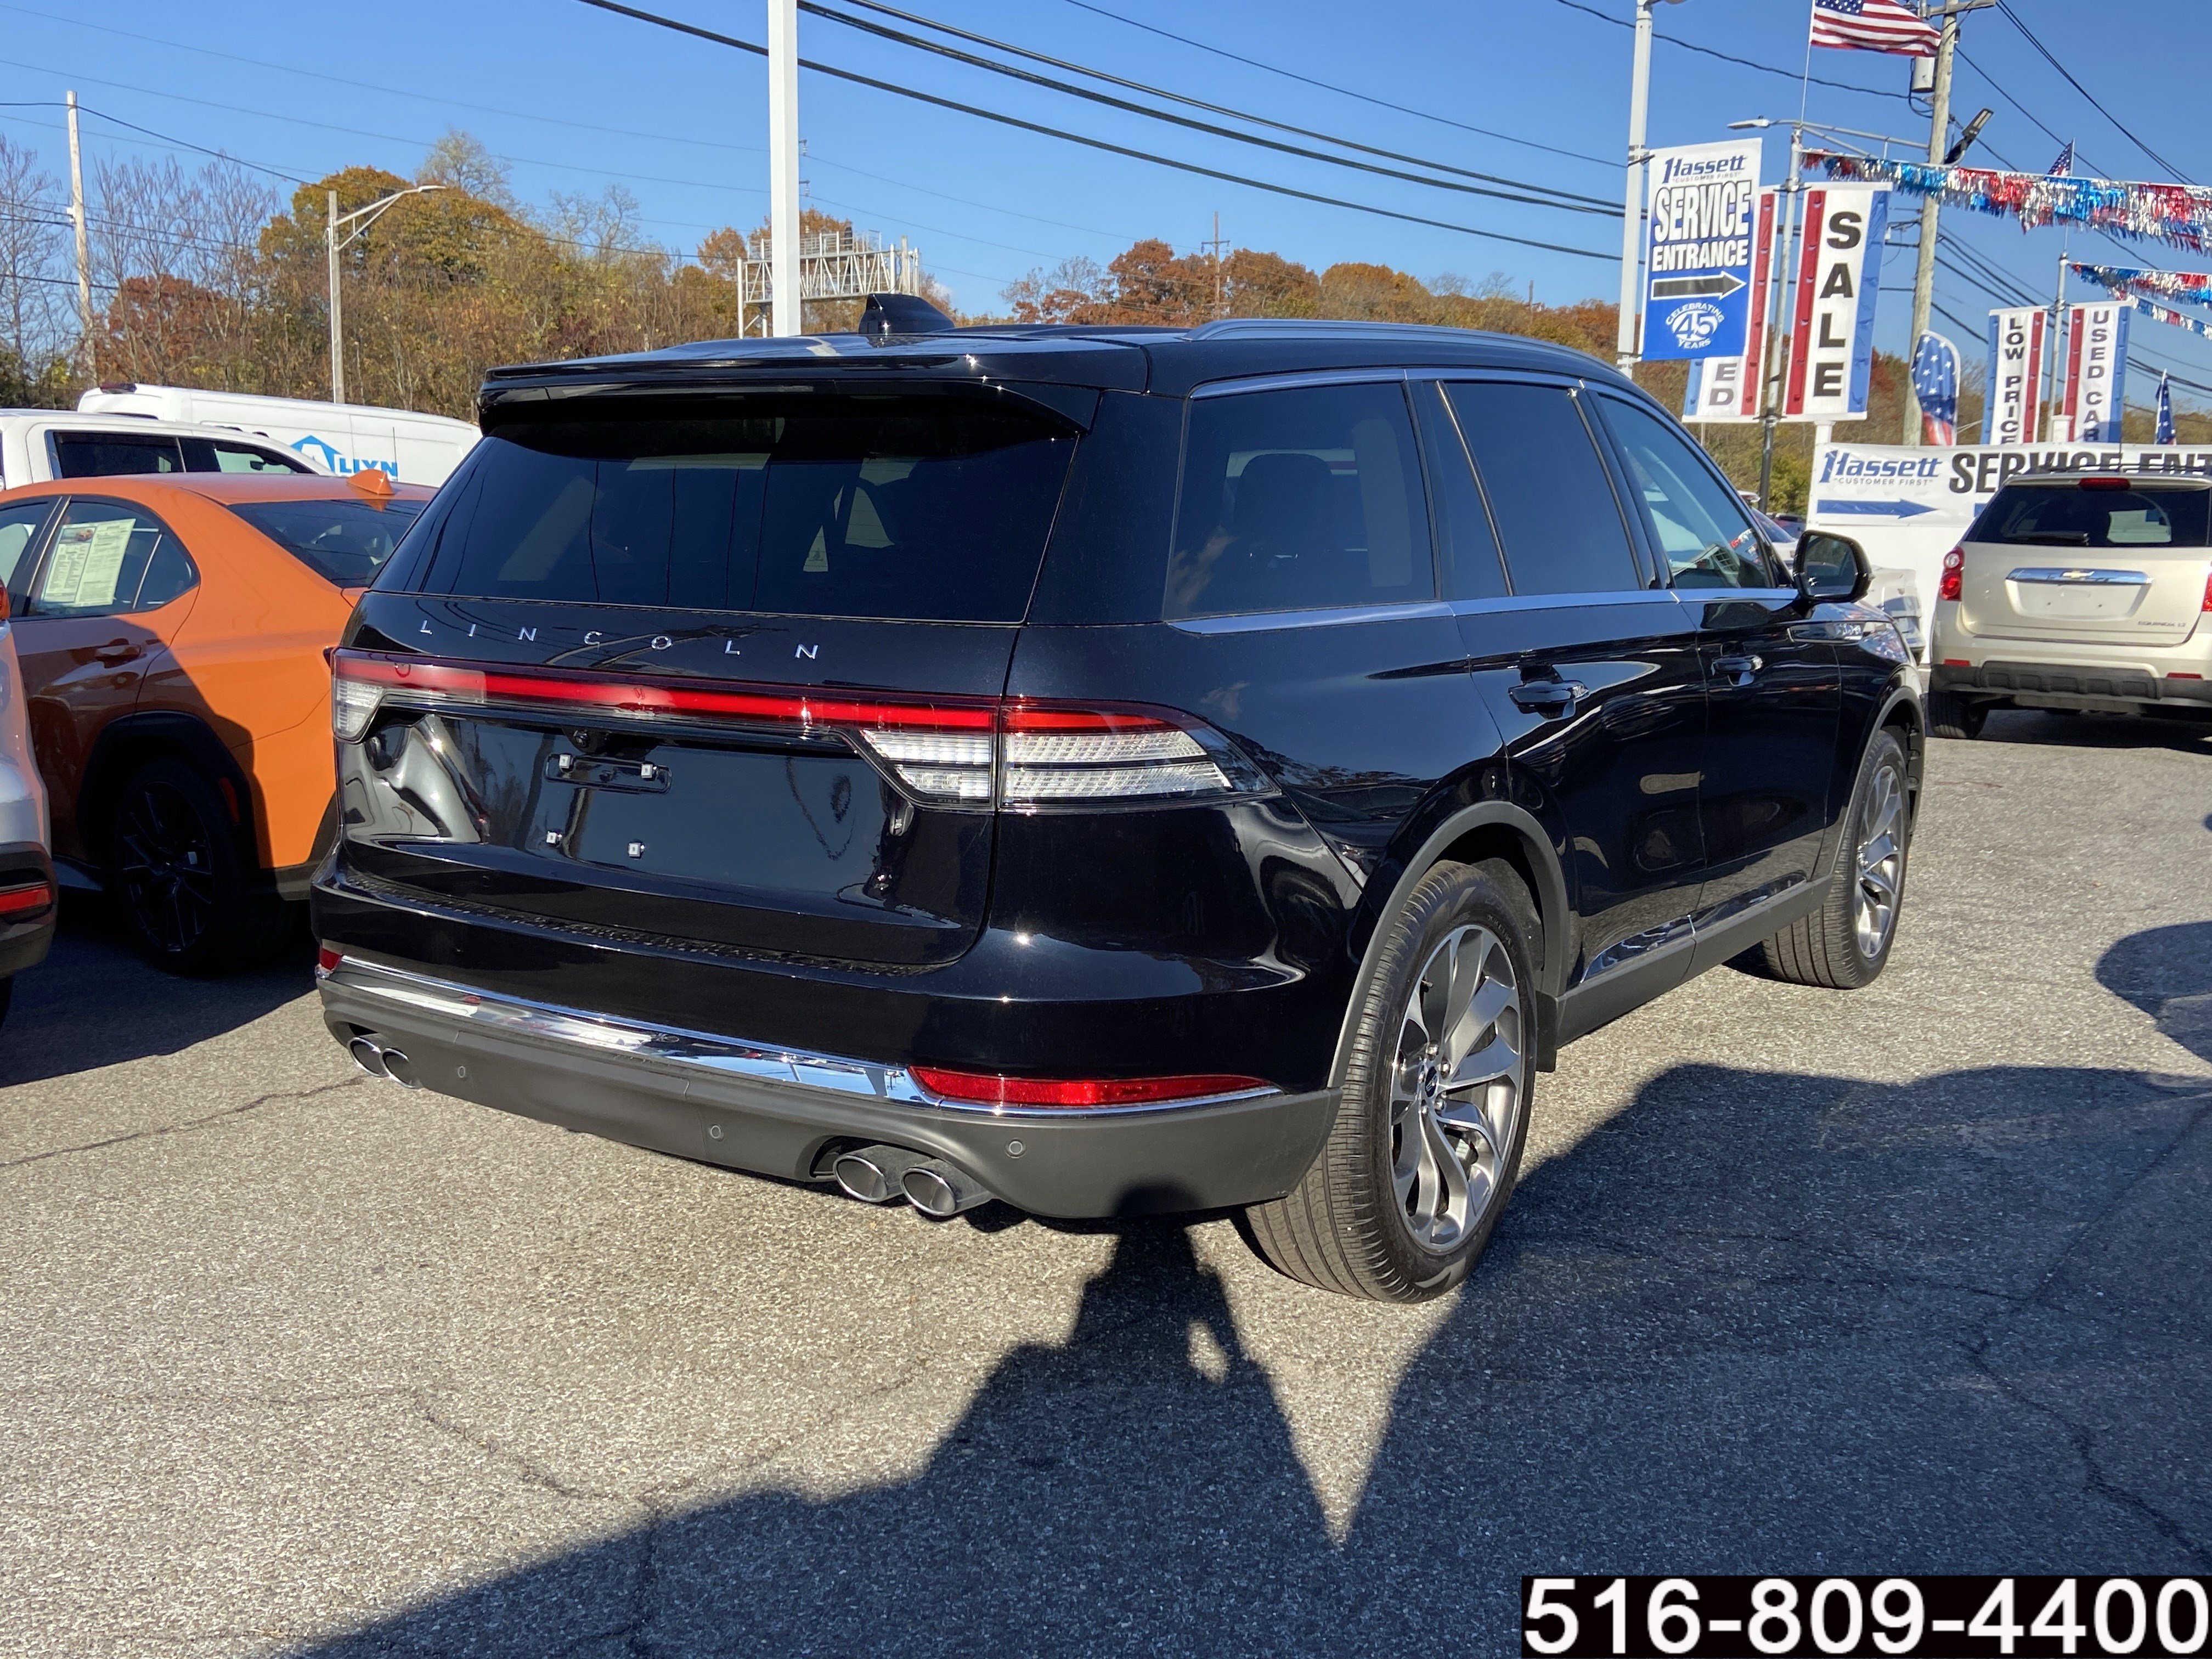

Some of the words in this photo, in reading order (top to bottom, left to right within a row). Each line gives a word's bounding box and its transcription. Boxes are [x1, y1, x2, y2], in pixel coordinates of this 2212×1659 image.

[1662, 155, 1747, 183] Hassett
[1655, 180, 1751, 242] SERVICE
[1652, 239, 1749, 272] ENTRANCE
[1666, 302, 1725, 325] CELEBRATING
[1813, 211, 1863, 397] SALE
[1674, 313, 1714, 338] 45
[2005, 317, 2024, 360] LOW
[1678, 337, 1711, 349] YEARS
[2087, 309, 2109, 379] USED
[1819, 449, 1943, 483] Hassett
[419, 619, 819, 660] LINCOLN
